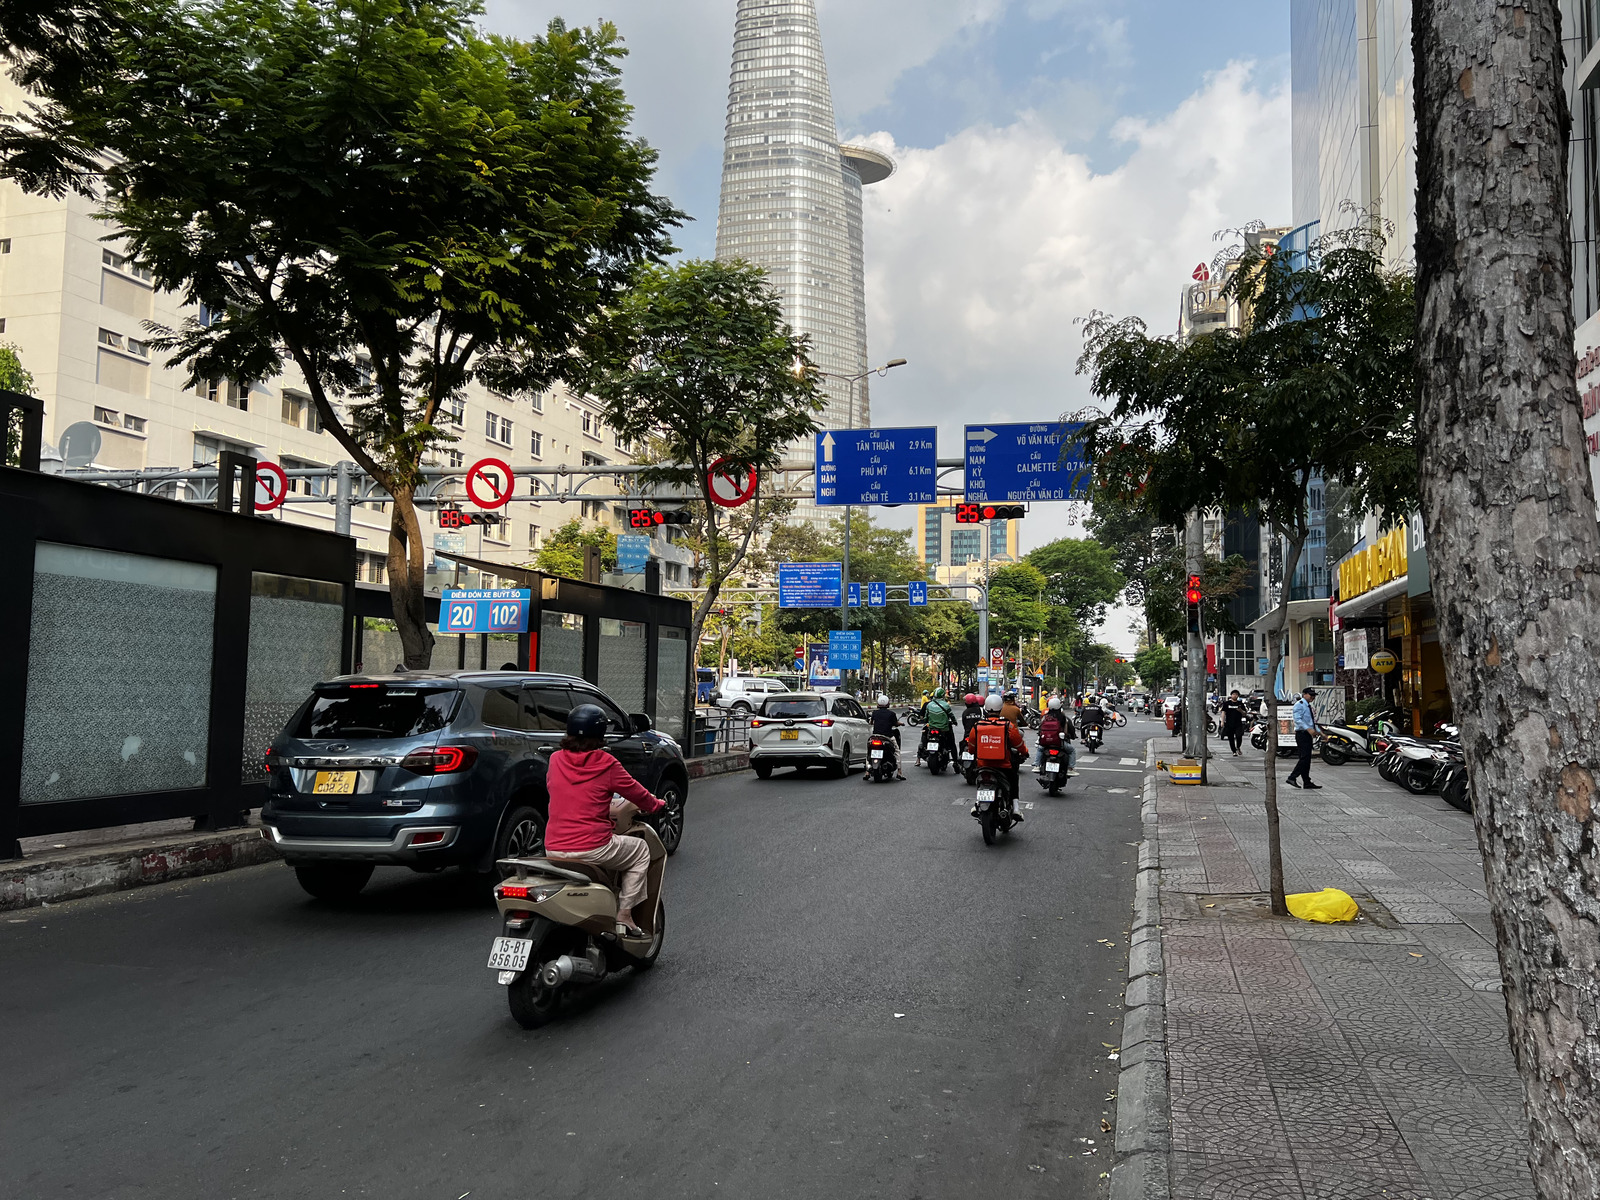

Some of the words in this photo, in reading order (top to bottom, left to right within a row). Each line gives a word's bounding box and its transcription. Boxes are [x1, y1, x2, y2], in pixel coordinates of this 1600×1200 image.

[856, 440, 869, 451] TÂN
[872, 439, 895, 452] THUẬN
[921, 441, 932, 449] Km
[1017, 435, 1026, 445] VÕ
[1028, 434, 1042, 445] VĂN
[1044, 432, 1060, 446] KIỆT
[969, 456, 985, 464] NAM
[860, 465, 874, 476] PHÚ
[877, 465, 887, 475] MỸ
[920, 466, 931, 475] Km
[1017, 462, 1057, 473] CALMETTE
[821, 473, 836, 483] HÀM
[821, 488, 836, 497] NGHI
[861, 491, 878, 502] KÊNH
[920, 492, 932, 501] Km
[968, 492, 988, 501] NGHĨA
[1008, 487, 1036, 500] NGUYỄN
[1038, 488, 1051, 499] VĂN
[441, 511, 459, 527] 25
[631, 510, 651, 527] 25
[958, 505, 978, 522] 25
[468, 590, 481, 598] ĐÓN
[451, 606, 473, 625] 20
[492, 605, 518, 625] 102
[500, 940, 526, 955] 15-B1
[492, 953, 526, 969] 956.05
